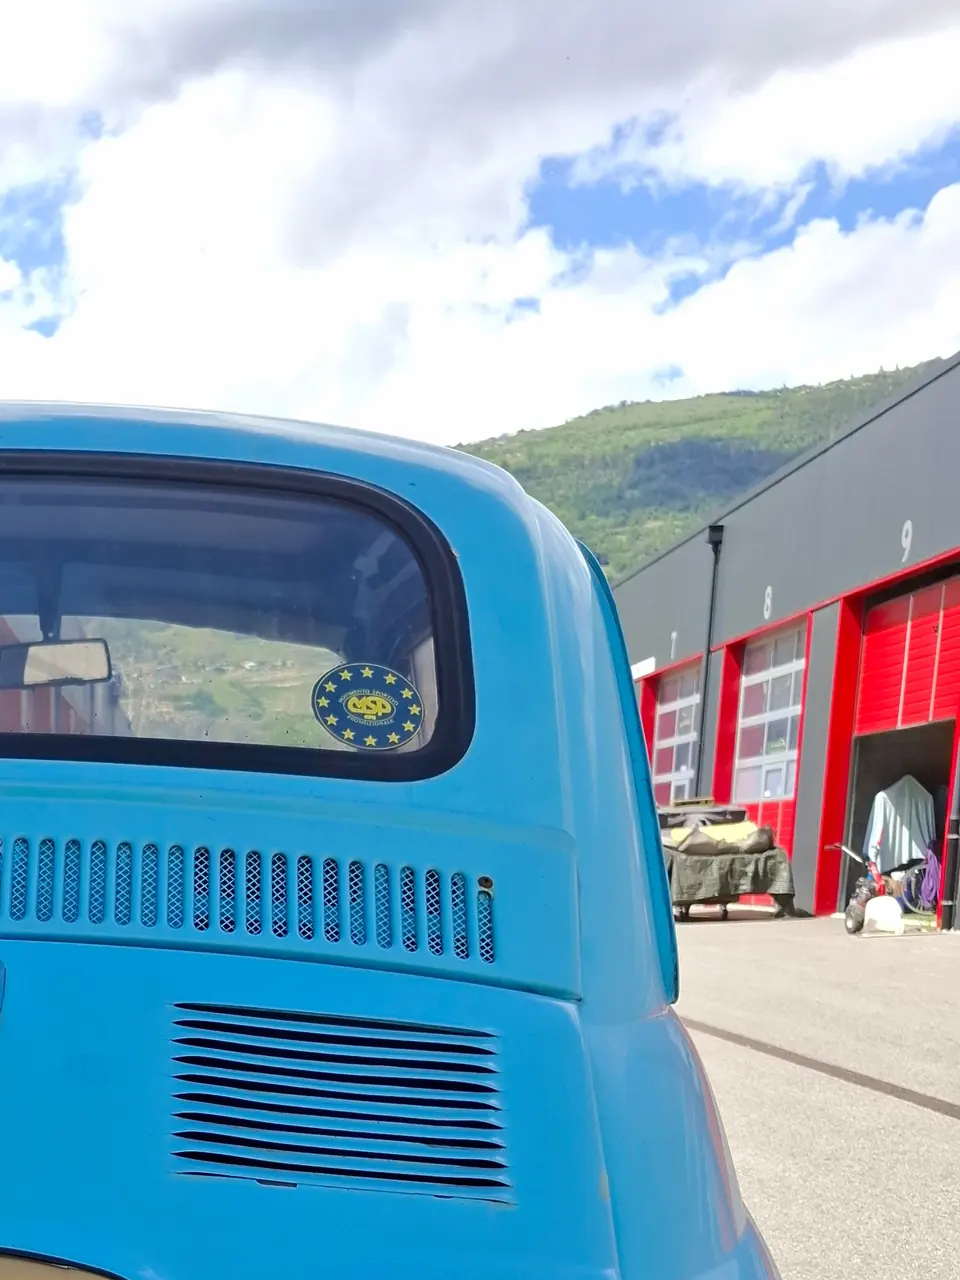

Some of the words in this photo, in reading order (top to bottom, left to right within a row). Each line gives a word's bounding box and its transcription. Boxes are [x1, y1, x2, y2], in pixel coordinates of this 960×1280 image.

[901, 519, 913, 563] 9
[763, 585, 773, 620] 8
[347, 696, 392, 717] MSP
